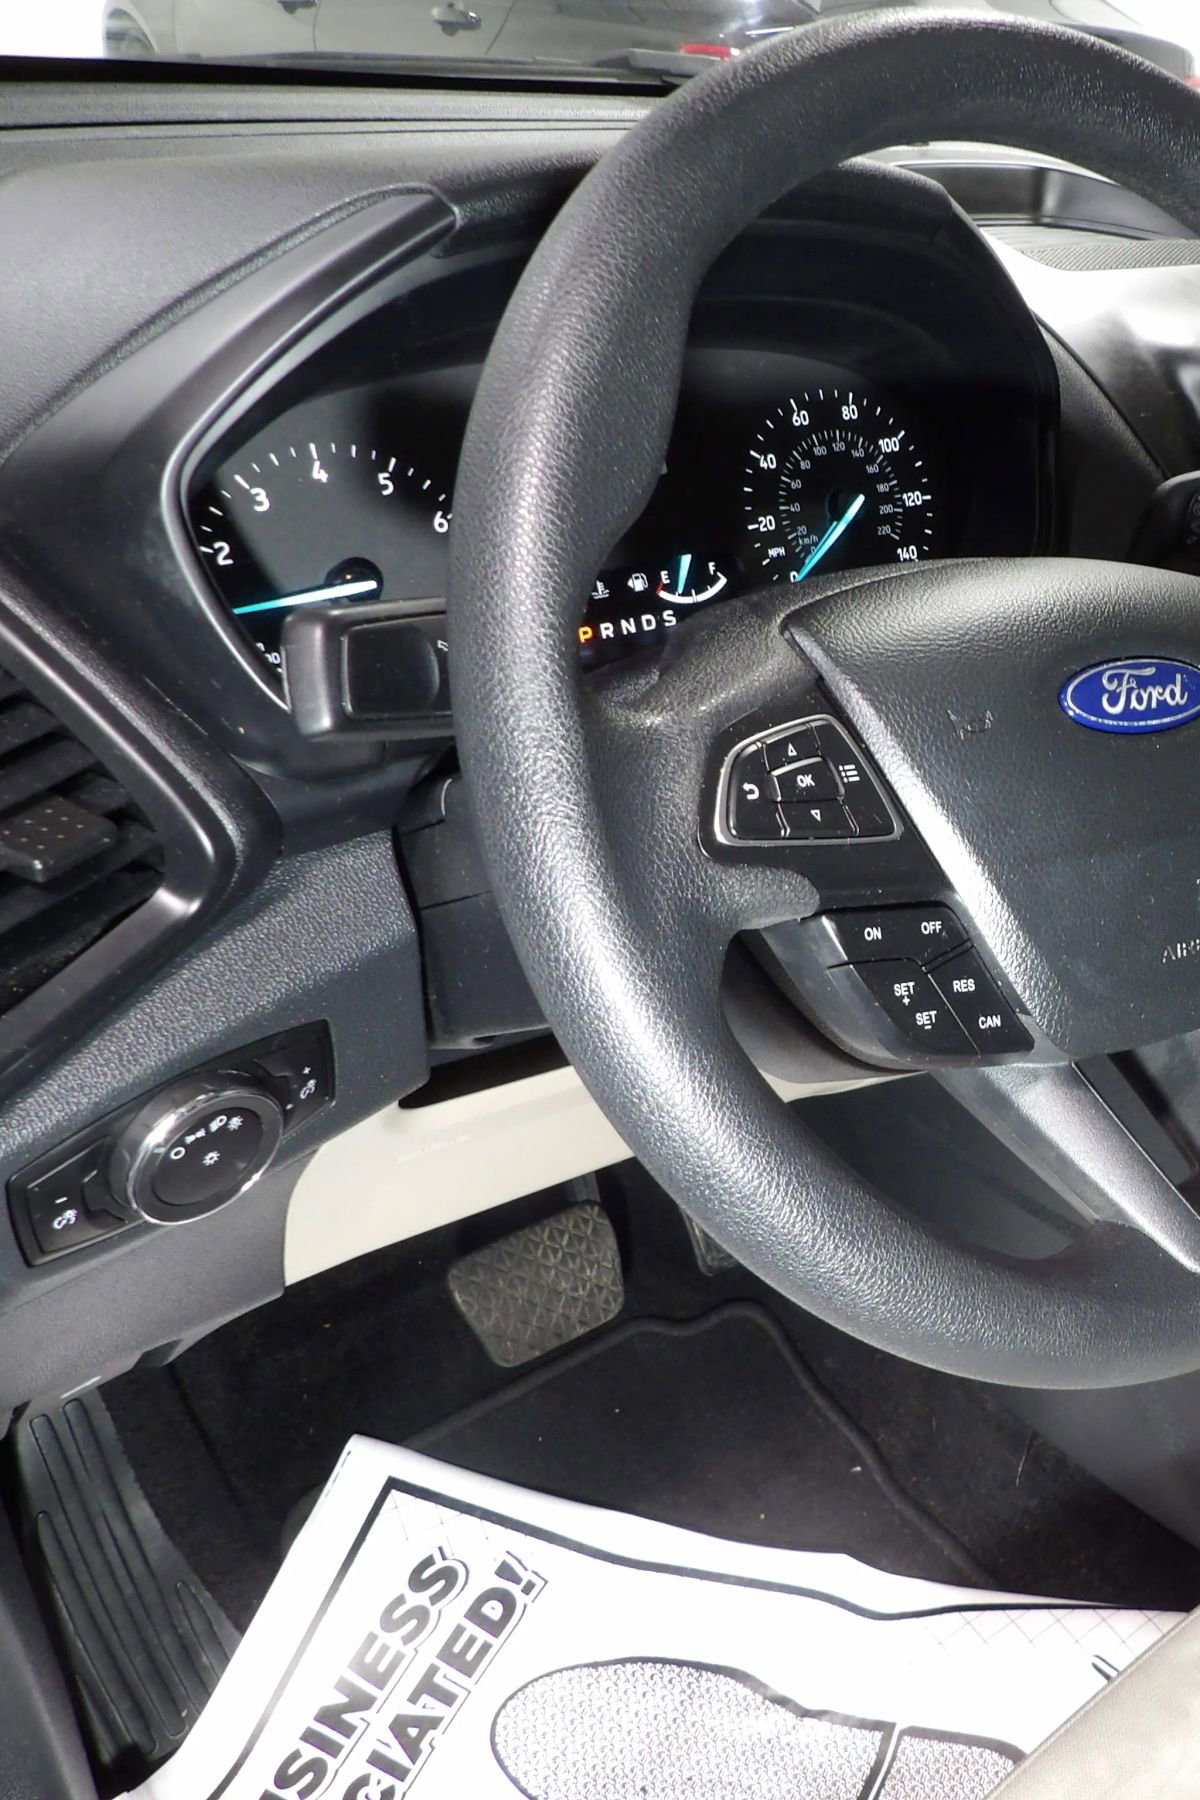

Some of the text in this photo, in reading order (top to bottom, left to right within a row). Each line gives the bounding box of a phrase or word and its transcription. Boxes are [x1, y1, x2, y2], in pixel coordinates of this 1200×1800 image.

[792, 410, 809, 426] 60
[841, 405, 858, 420] 80
[813, 446, 827, 456] 100
[832, 441, 845, 451] 120
[879, 437, 900, 453] 100
[851, 448, 864, 458] 140
[759, 453, 777, 470] 40
[800, 460, 811, 470] 80
[866, 464, 879, 474] 160
[312, 460, 328, 483] 4
[377, 473, 394, 495] 5
[790, 480, 802, 489] 60
[876, 483, 890, 493] 180
[250, 488, 270, 511] 3
[902, 491, 922, 507] 120
[789, 503, 800, 512] 40
[879, 505, 894, 514] 200
[433, 511, 448, 533] 6
[758, 515, 775, 531] 20
[796, 526, 807, 535] 20
[877, 526, 891, 535] 220
[799, 535, 819, 545] km/h
[213, 541, 234, 566] 2
[768, 547, 785, 558] MPH
[897, 546, 918, 561] 140
[708, 562, 716, 575] F
[660, 570, 671, 584] E
[1102, 667, 1188, 715] Ford
[797, 774, 815, 788] OK
[864, 920, 942, 941] ON OFF
[894, 981, 915, 997] SET
[953, 978, 975, 993] RES
[915, 1010, 937, 1026] SET
[978, 1014, 1001, 1030] CAN
[260, 1551, 460, 1800] SINESS
